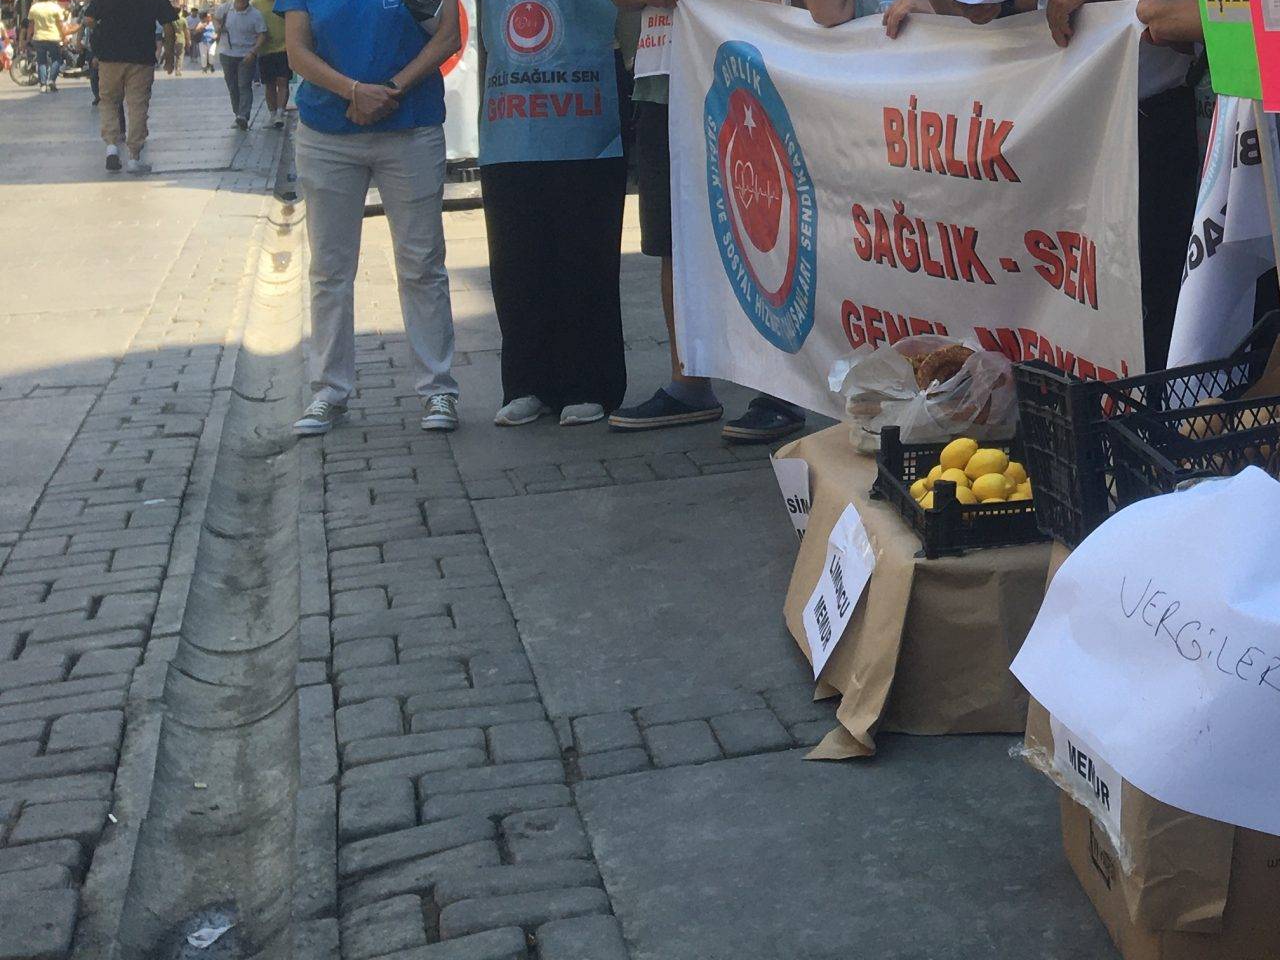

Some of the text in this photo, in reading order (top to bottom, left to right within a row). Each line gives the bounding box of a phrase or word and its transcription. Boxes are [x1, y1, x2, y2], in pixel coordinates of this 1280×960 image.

[648, 14, 673, 29] BİRL
[510, 67, 567, 84] SAĞLIK
[571, 69, 600, 83] SEN
[883, 94, 1021, 183] BİRLİK
[716, 199, 727, 223] VE
[723, 231, 751, 303] SOSYAL
[851, 200, 997, 286] SAĞLIK
[1023, 229, 1098, 310] SEN
